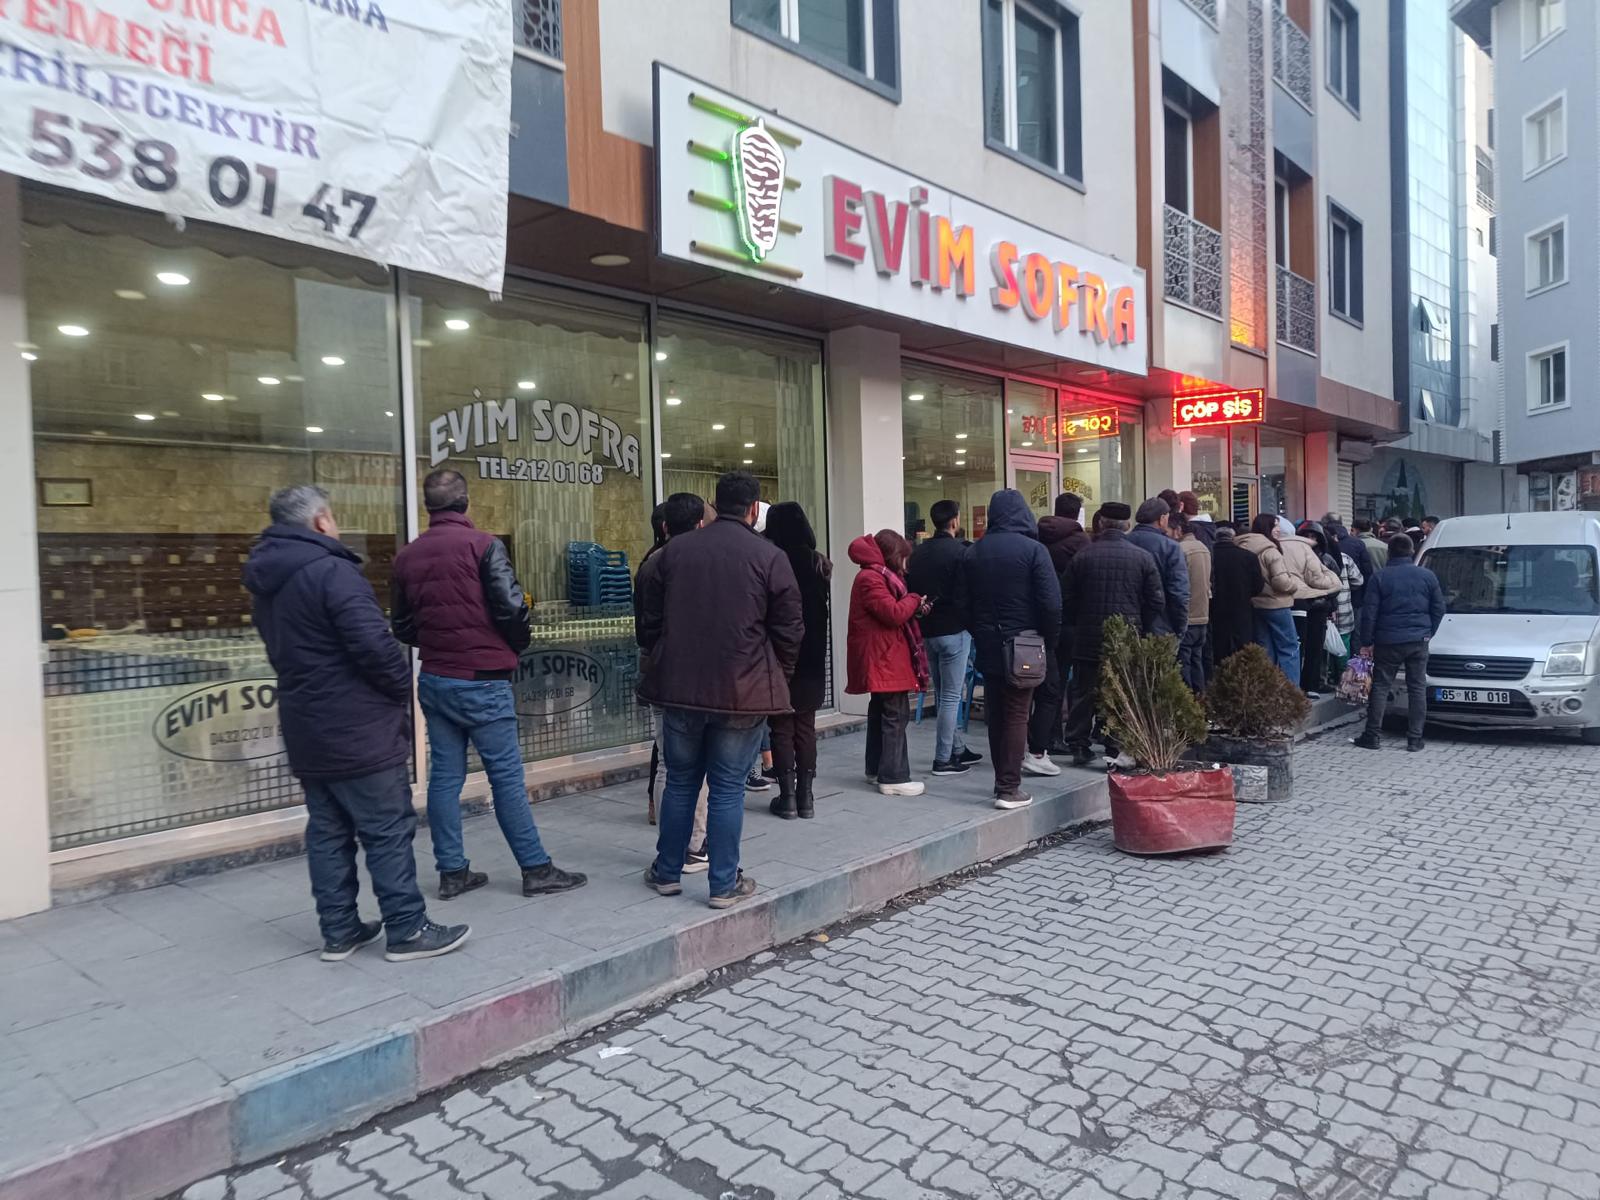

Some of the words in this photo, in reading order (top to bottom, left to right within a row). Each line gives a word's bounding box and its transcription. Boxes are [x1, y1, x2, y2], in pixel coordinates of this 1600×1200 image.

[0, 0, 214, 85] EMEĞİ
[0, 42, 319, 159] RİLECEKTİR
[27, 107, 179, 193] 538
[208, 154, 279, 217] 01
[302, 183, 377, 239] 47
[990, 240, 1136, 346] SOFRA
[532, 399, 641, 479] SOFRA
[1181, 400, 1219, 422] ÇÖP
[1222, 395, 1252, 418] ŞİŞ
[542, 655, 598, 683] SOFRA
[1442, 689, 1455, 700] 65
[1464, 690, 1478, 701] KB
[1487, 691, 1508, 703] 018
